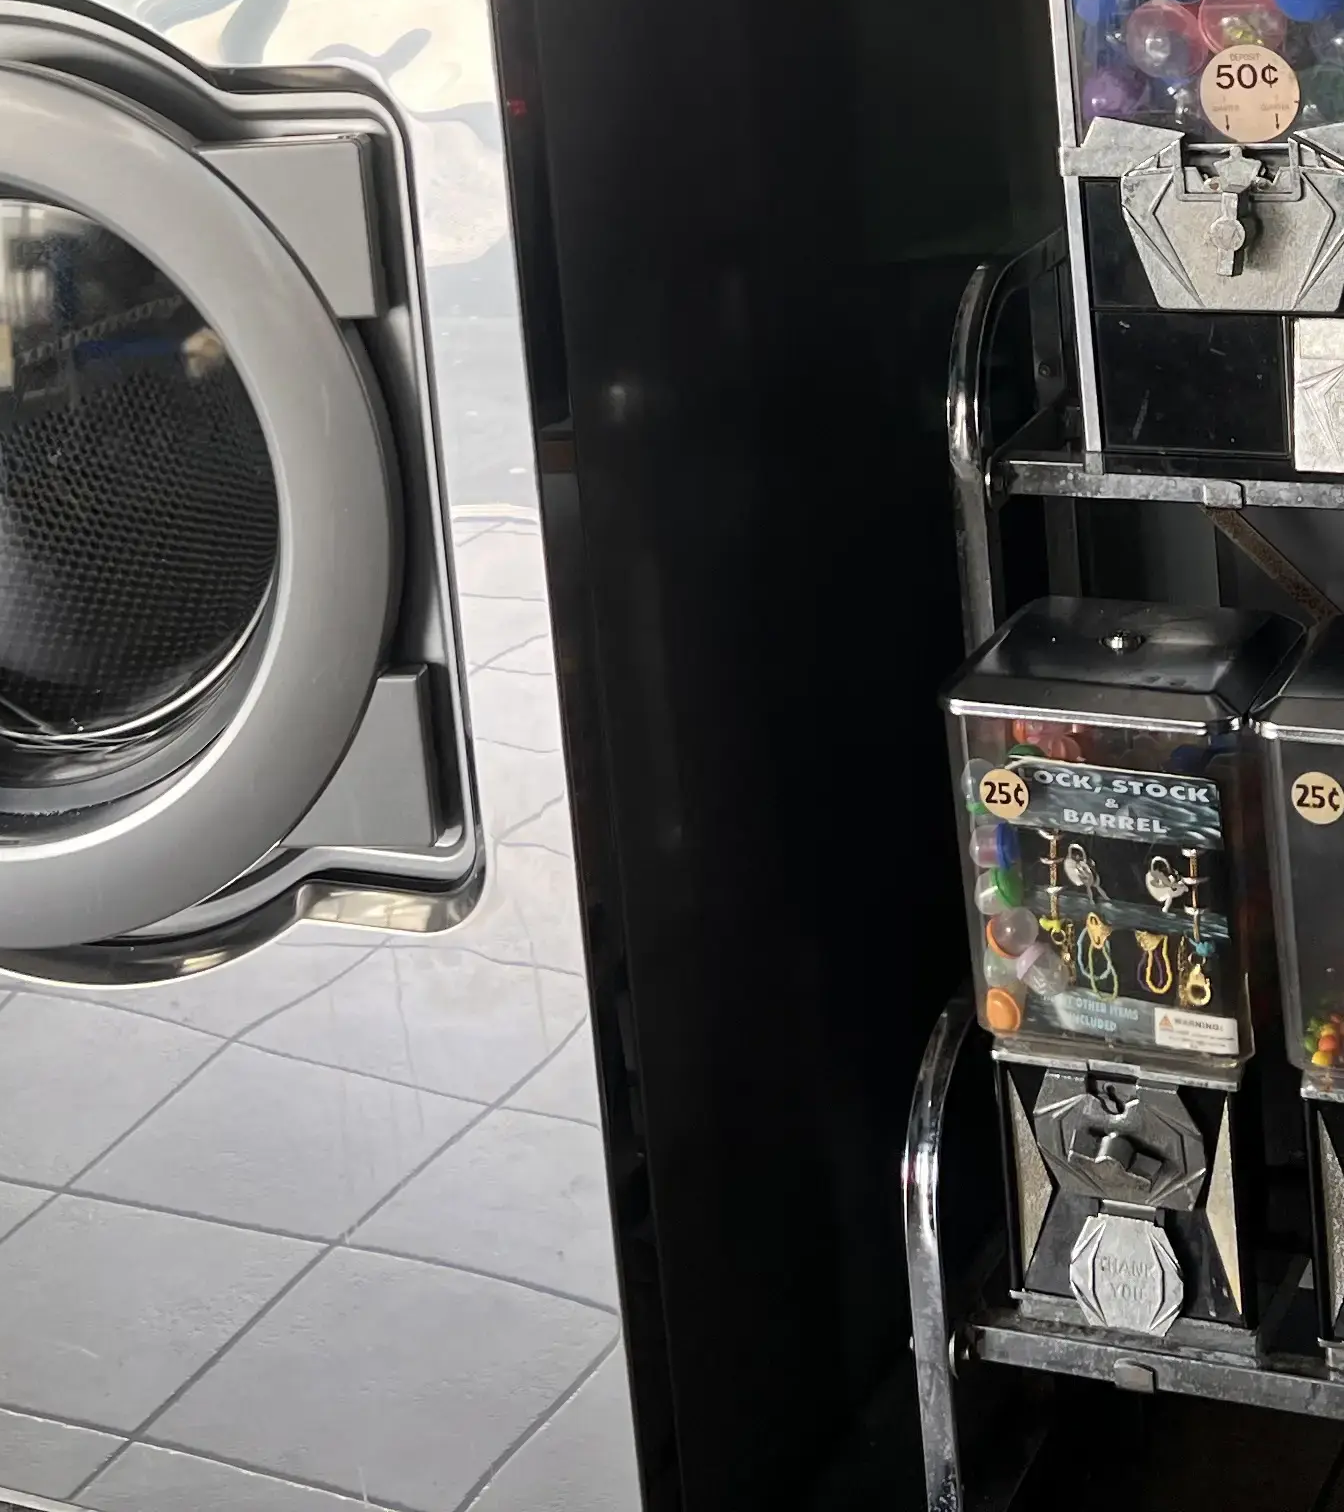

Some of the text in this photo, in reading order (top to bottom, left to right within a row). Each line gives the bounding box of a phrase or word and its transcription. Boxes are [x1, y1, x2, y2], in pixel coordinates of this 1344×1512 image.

[1216, 63, 1279, 89] 50¢
[984, 780, 1026, 807] 25¢
[1105, 798, 1119, 809] &
[1112, 779, 1210, 803] STOCK
[1295, 783, 1341, 812] 25¢
[1063, 808, 1168, 834] BARREL
[1109, 1002, 1139, 1021] ITEMS
[1096, 1253, 1156, 1280] THANK
[1109, 1281, 1147, 1302] YOU
